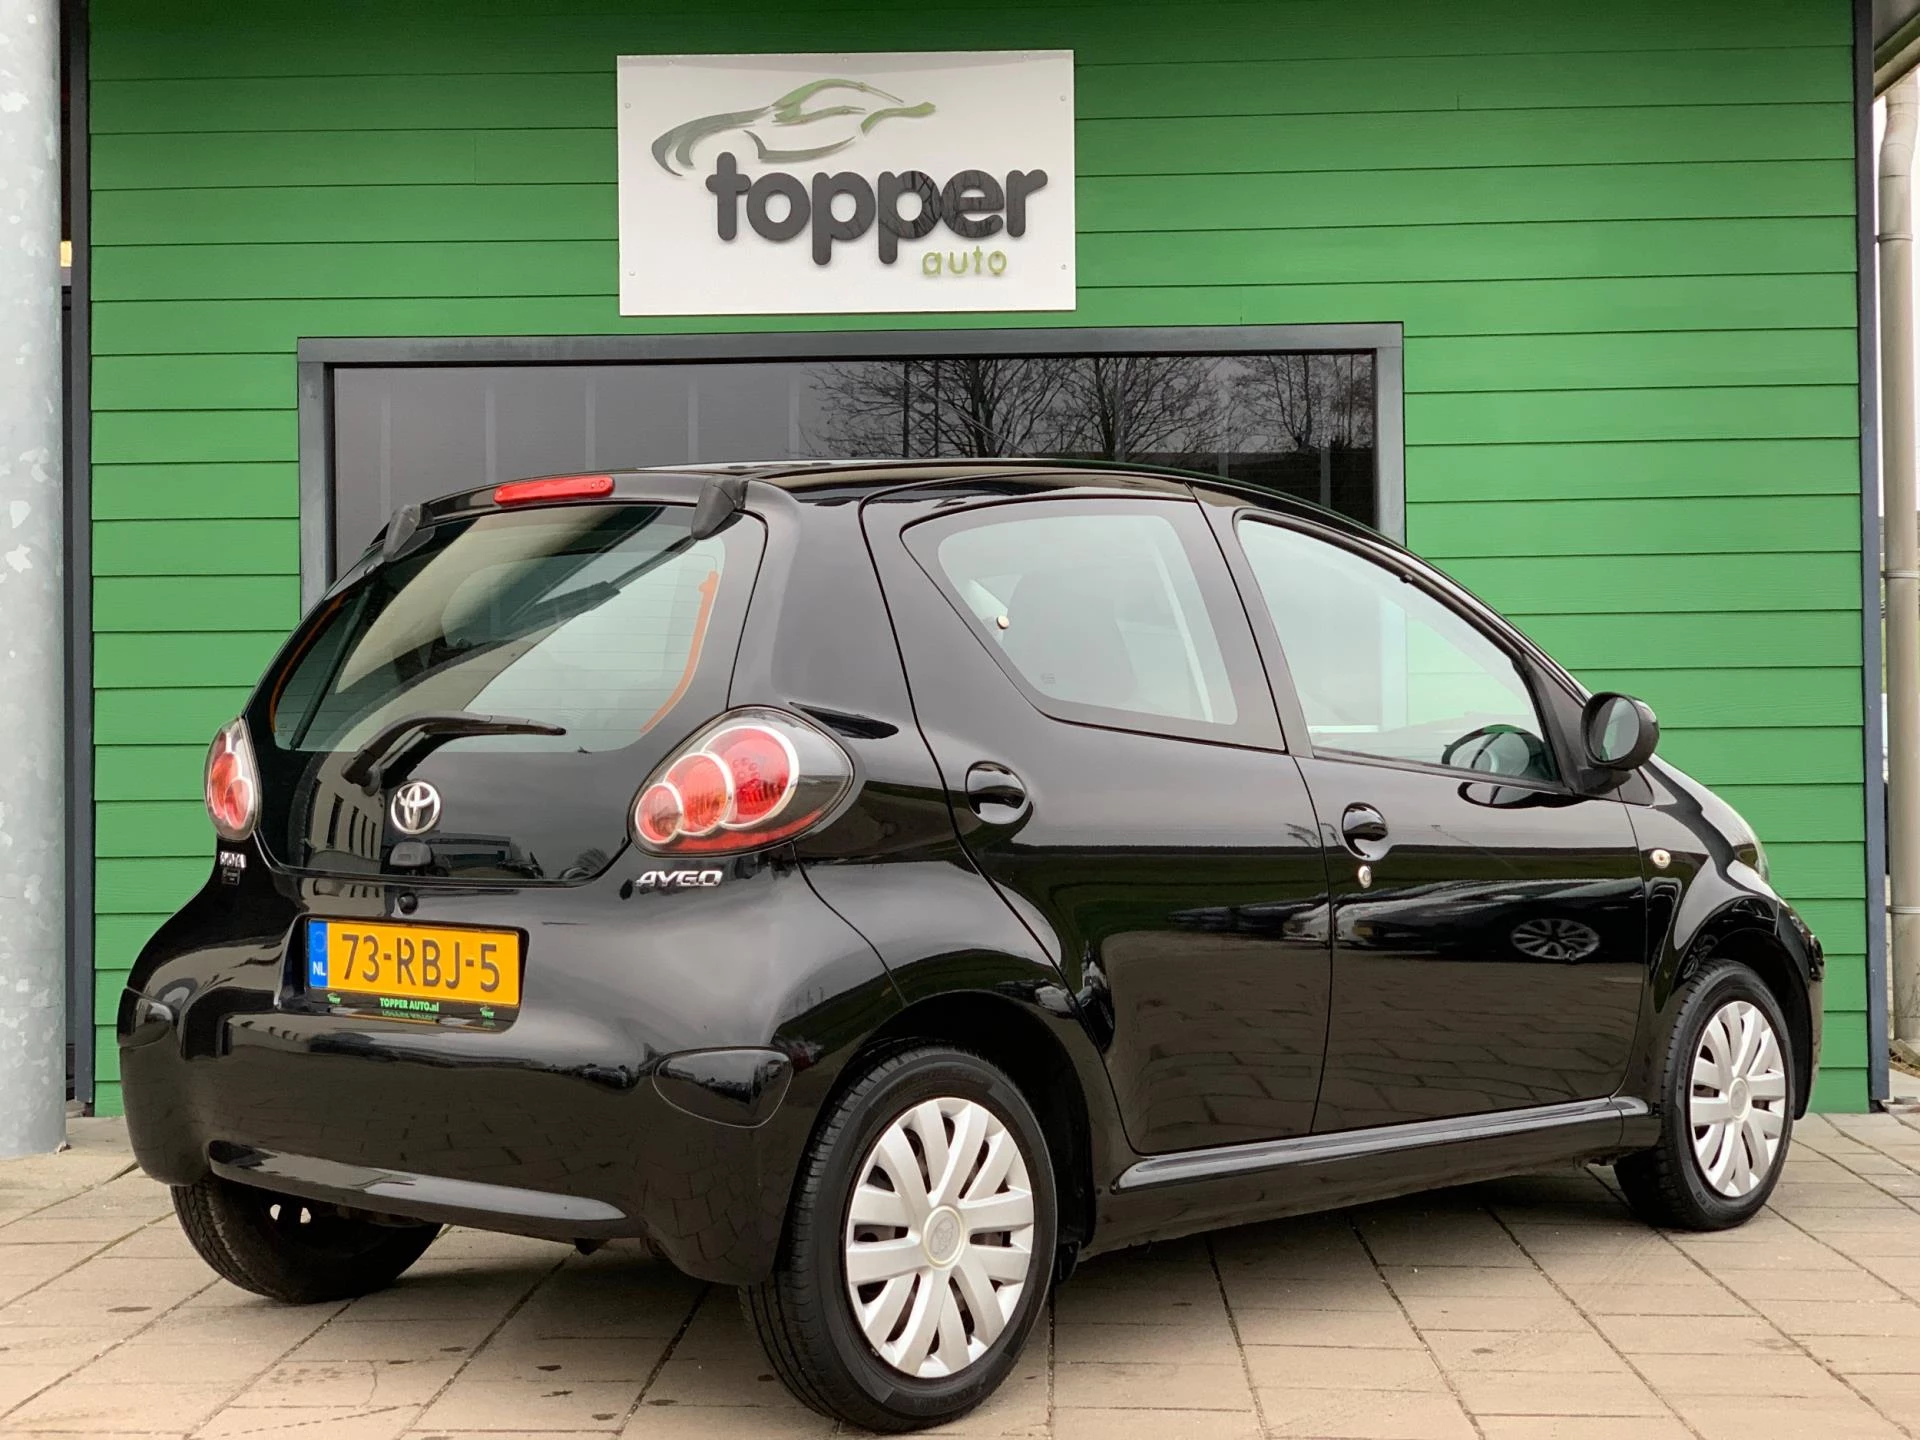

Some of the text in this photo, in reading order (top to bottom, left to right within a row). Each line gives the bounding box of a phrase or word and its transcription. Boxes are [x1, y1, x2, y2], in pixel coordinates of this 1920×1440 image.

[705, 151, 1048, 266] topper
[922, 245, 1008, 276] auto
[635, 870, 723, 887] AYGO
[312, 961, 327, 977] NL
[341, 933, 500, 993] 73-RBJ-5
[379, 997, 440, 1013] TOPPER AUTO.nl
